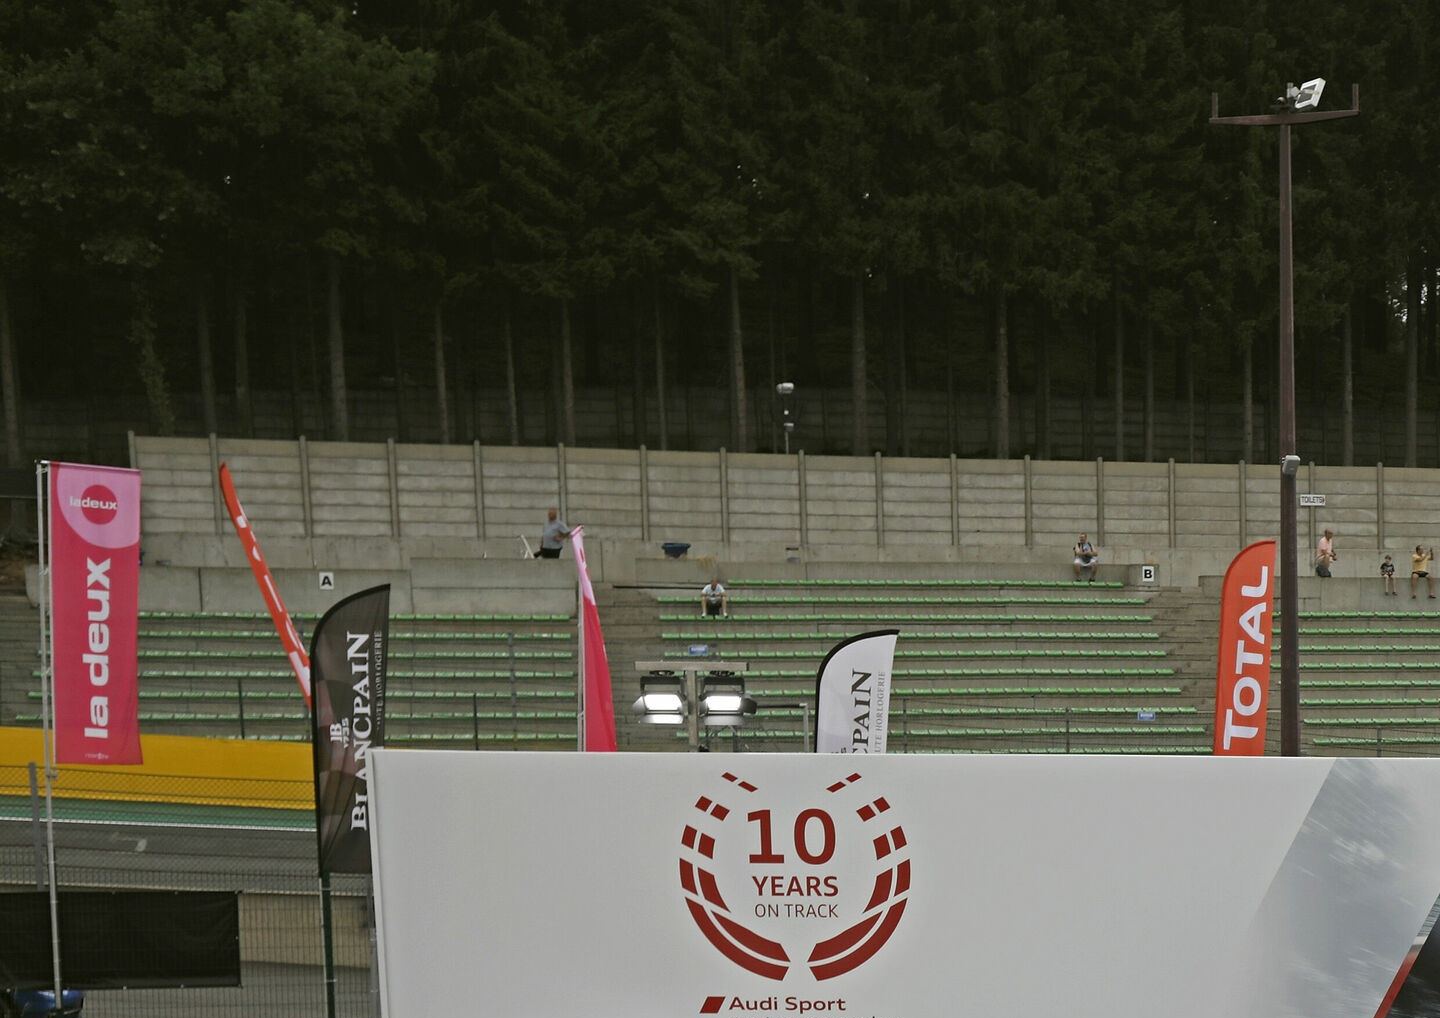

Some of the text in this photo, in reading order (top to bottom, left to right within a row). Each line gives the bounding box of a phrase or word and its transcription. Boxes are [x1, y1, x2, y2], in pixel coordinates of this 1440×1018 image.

[70, 496, 117, 510] ladeux
[321, 574, 332, 588] A
[1144, 568, 1152, 580] B
[82, 557, 112, 686] deux
[1222, 566, 1269, 750] TOTAL
[84, 696, 108, 739] la
[748, 808, 836, 864] 10
[752, 876, 839, 896] YEARS
[754, 904, 838, 918] ON TRACK
[728, 997, 846, 1014] Audi Sport
